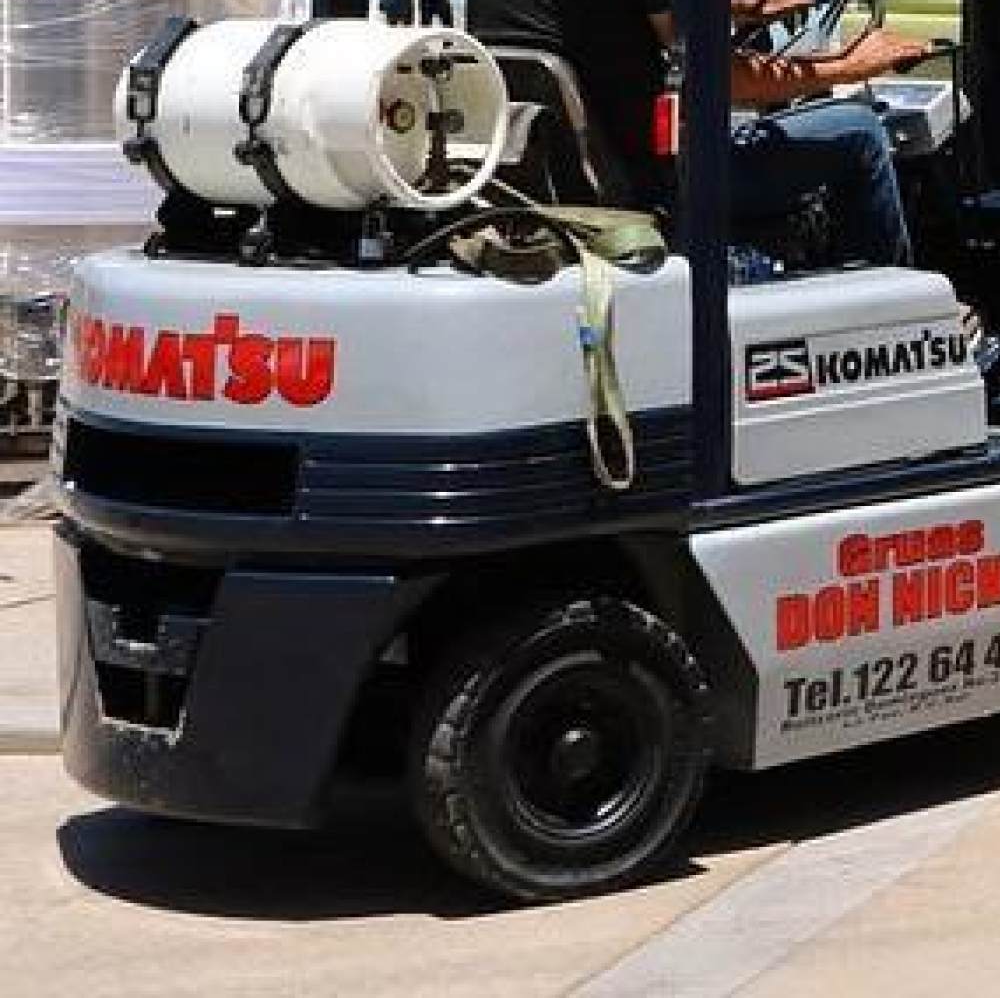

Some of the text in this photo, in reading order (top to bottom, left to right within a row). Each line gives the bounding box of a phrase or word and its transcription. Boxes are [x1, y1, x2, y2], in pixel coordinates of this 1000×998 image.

[815, 330, 968, 386] KOMATSU
[777, 579, 880, 651] DON
[928, 638, 975, 683] 64
